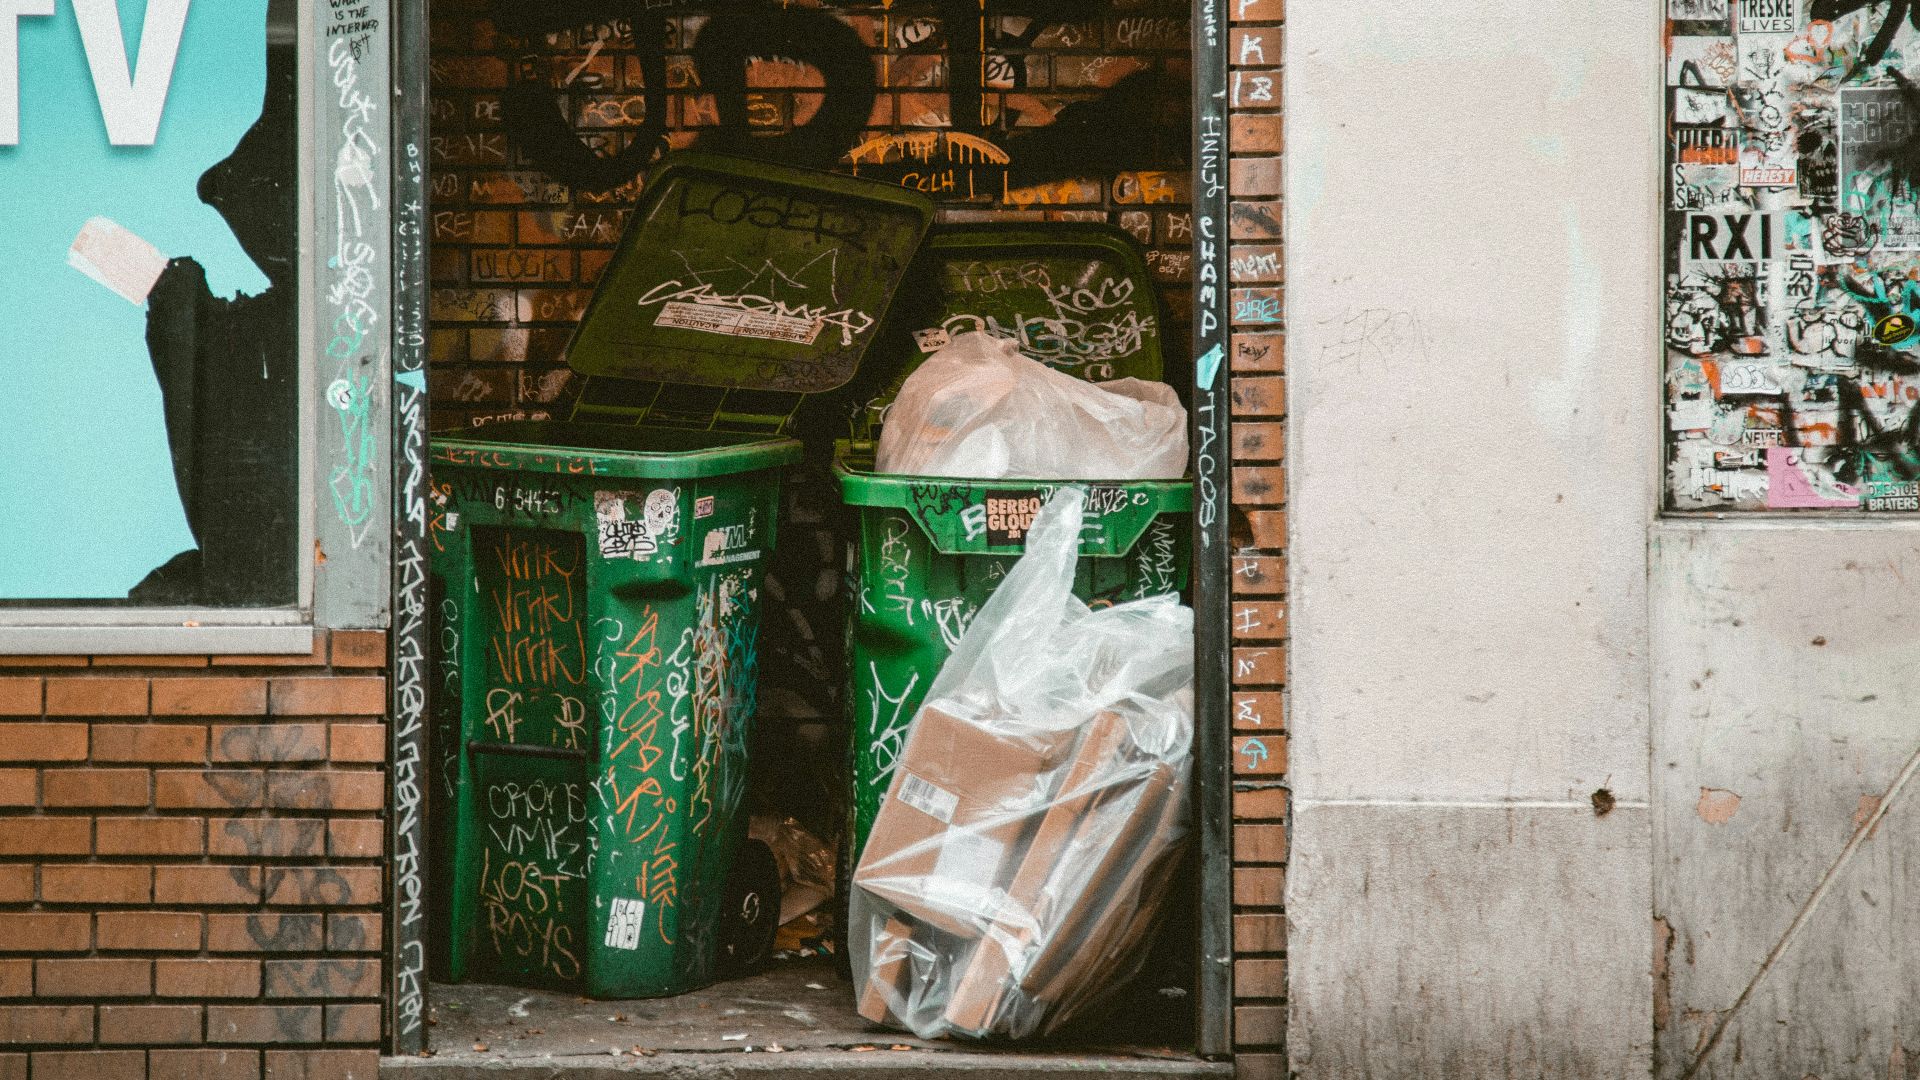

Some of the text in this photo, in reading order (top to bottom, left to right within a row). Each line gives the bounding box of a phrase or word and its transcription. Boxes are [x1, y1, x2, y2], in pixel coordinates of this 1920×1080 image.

[1741, 19, 1792, 31] LIVES
[1691, 214, 1771, 260] RXI
[987, 498, 1041, 515] BERBO
